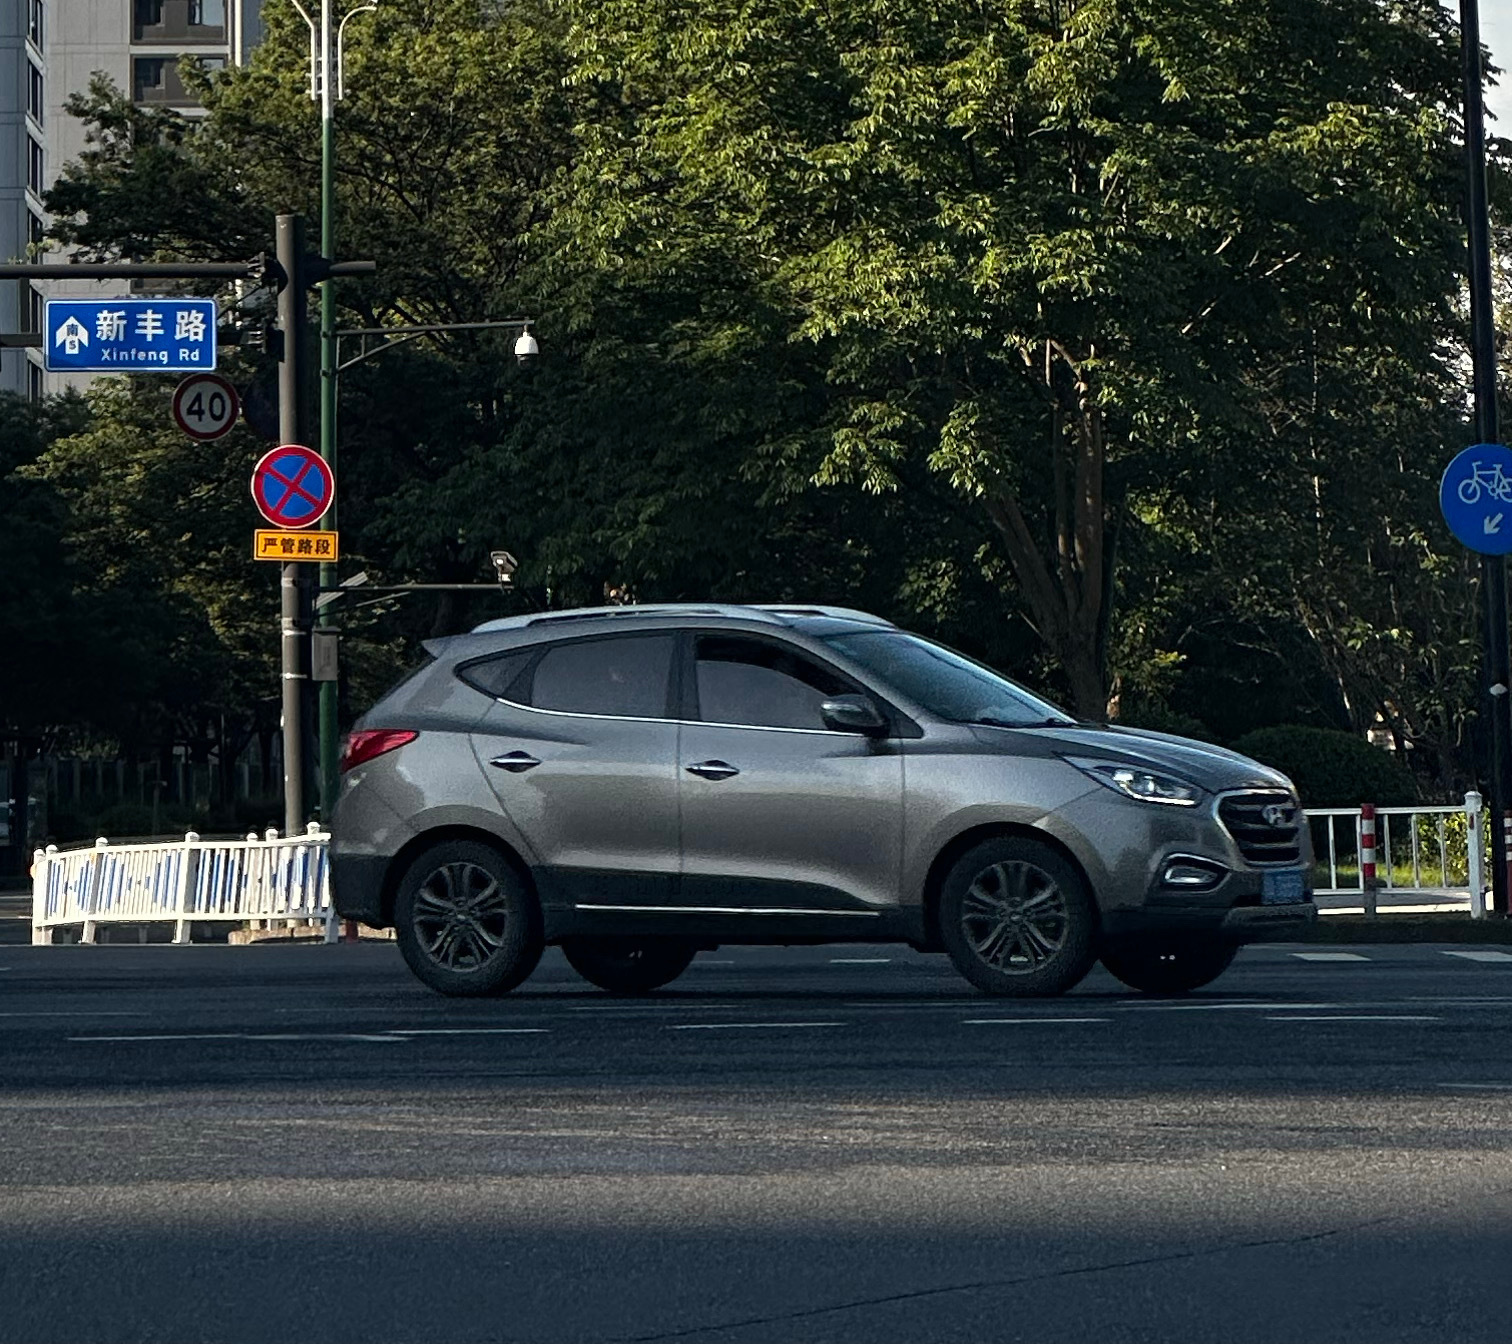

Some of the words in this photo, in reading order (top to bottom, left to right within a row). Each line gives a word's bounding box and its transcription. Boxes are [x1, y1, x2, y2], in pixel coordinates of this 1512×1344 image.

[96, 309, 206, 342] 新丰路
[69, 340, 76, 350] S
[101, 348, 168, 364] Xinfeng
[179, 348, 200, 361] Rd
[186, 392, 226, 422] 40
[262, 537, 330, 555] 严管路段
